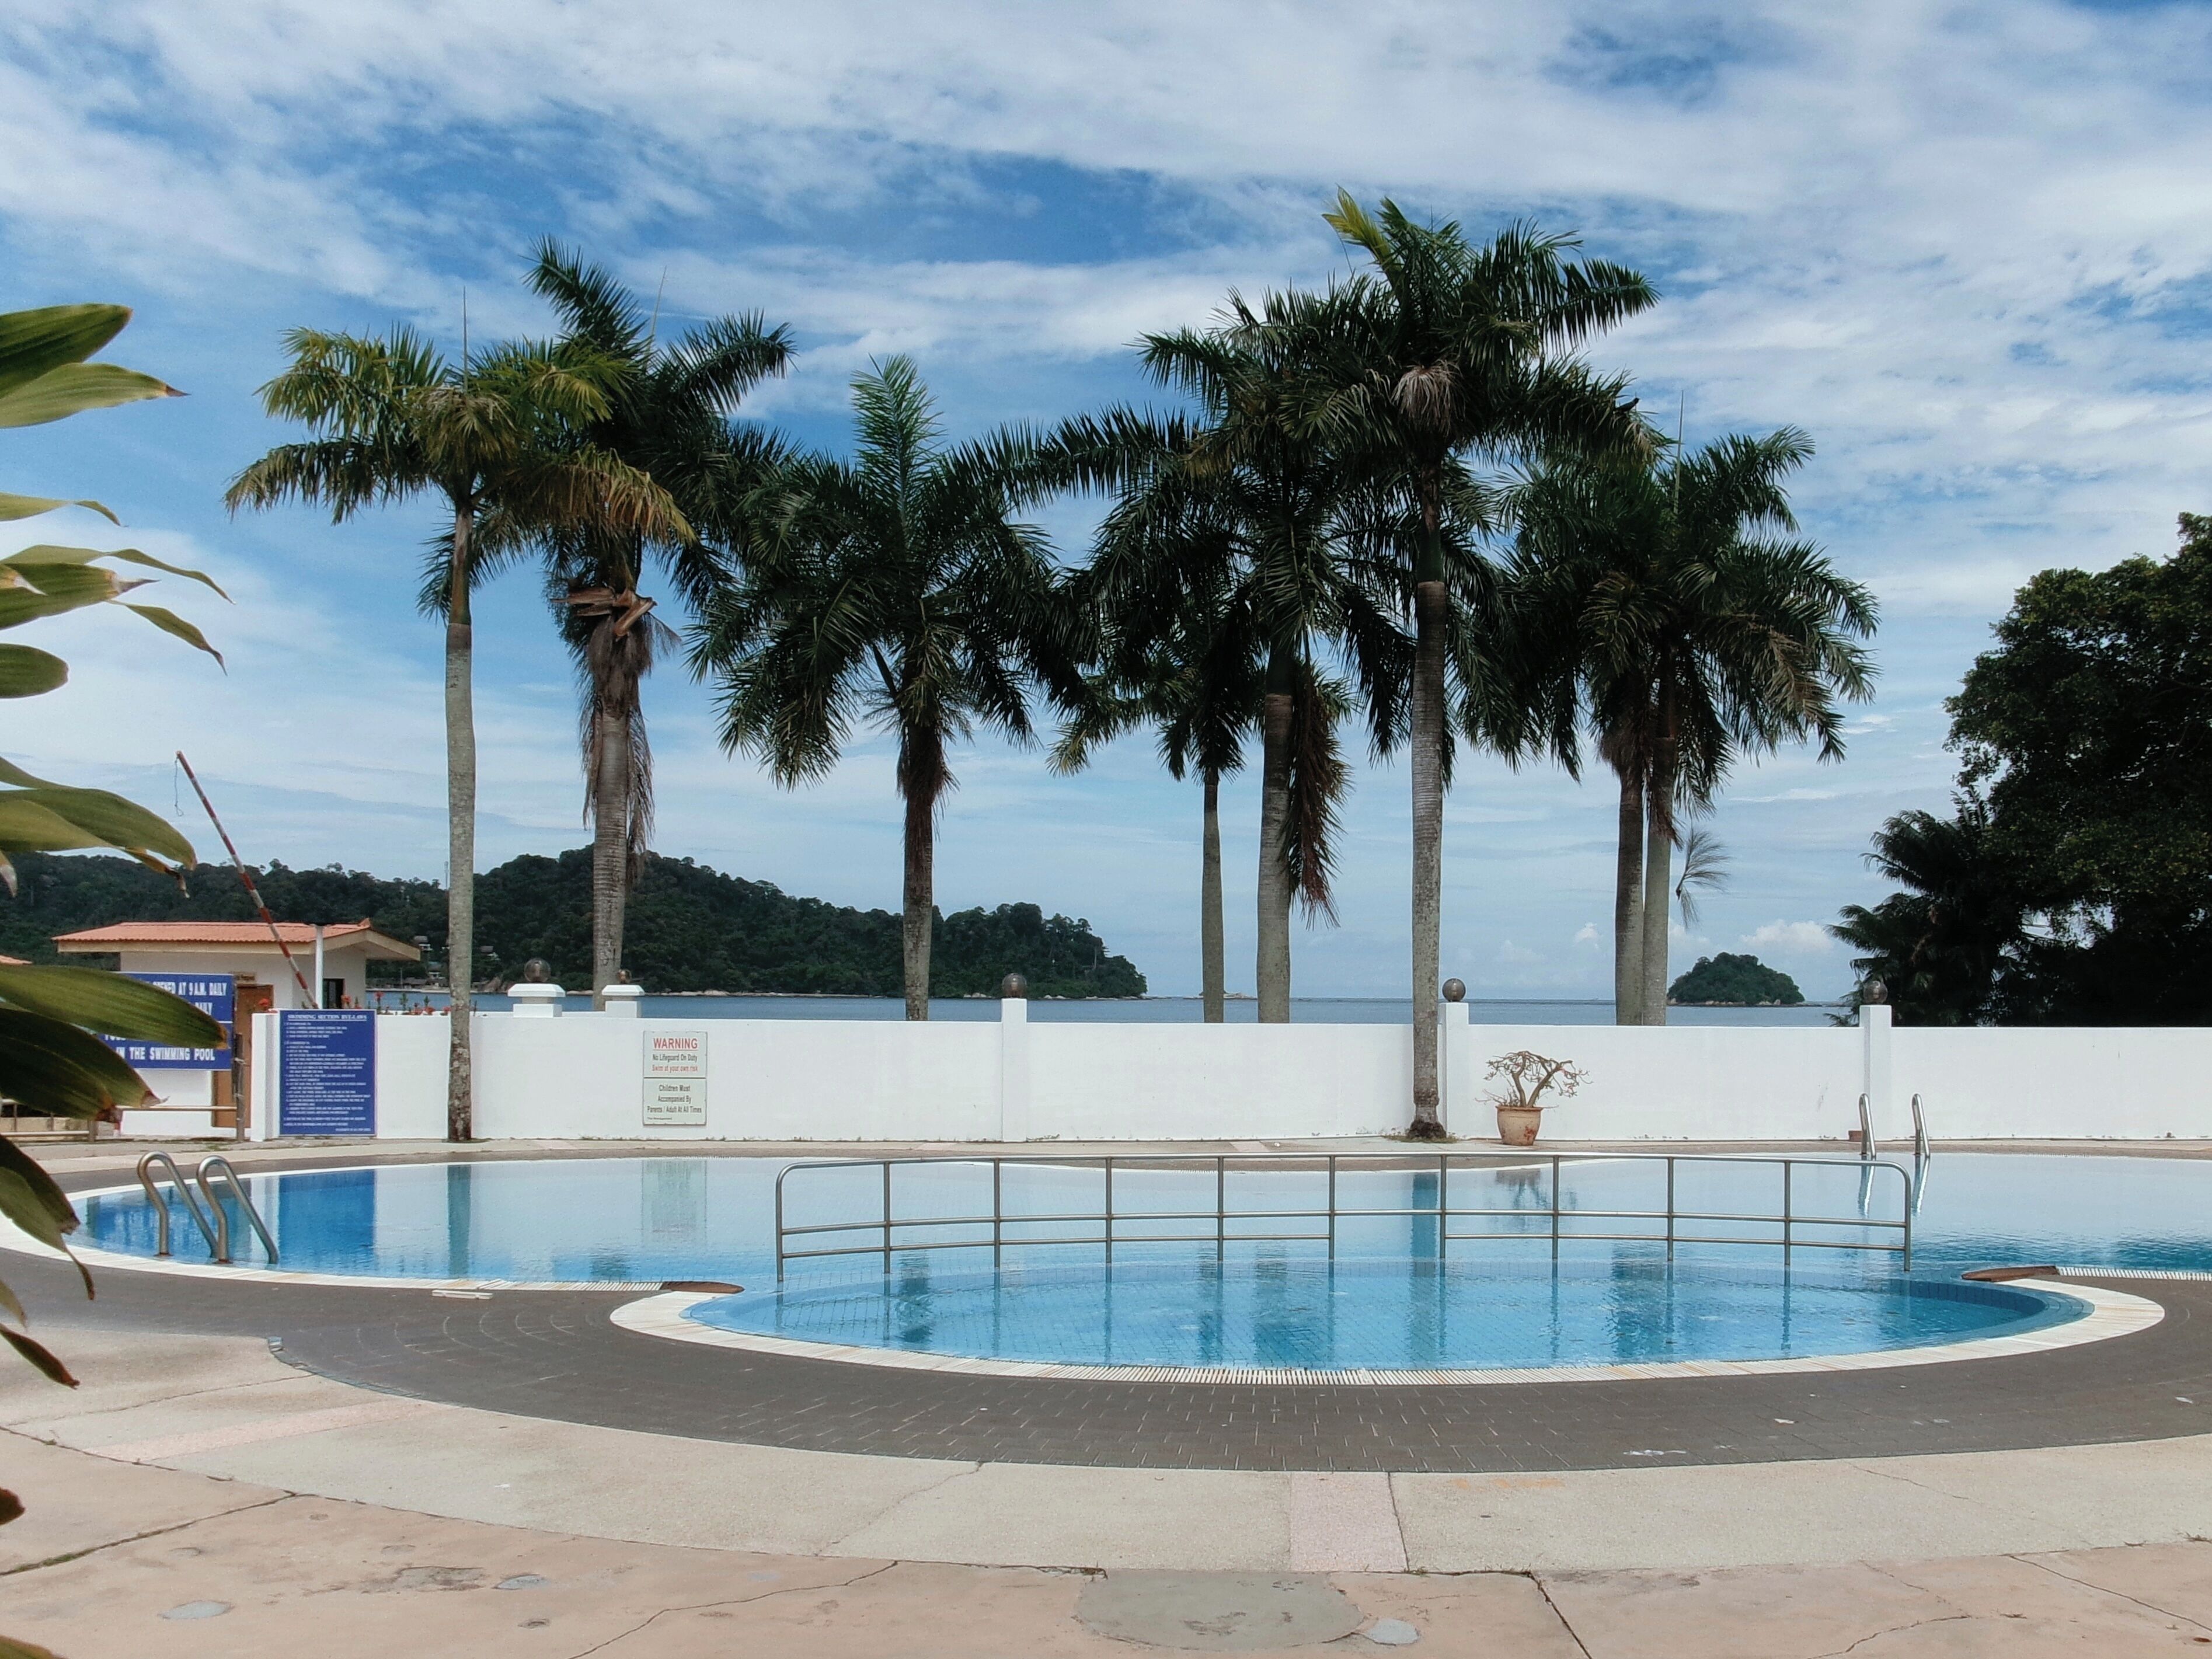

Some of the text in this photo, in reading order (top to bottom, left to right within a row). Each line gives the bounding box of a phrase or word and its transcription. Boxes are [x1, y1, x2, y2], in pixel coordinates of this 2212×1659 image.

[178, 982, 187, 995] AT
[209, 982, 227, 996] DAILY
[653, 1038, 698, 1049] WARNING
[129, 1047, 145, 1059] THE
[149, 1047, 190, 1060] SWIMMING
[194, 1048, 215, 1061] POOL
[659, 1054, 680, 1062] Lifeguard
[688, 1054, 697, 1062] Duty
[658, 1095, 691, 1104] Accompanied By
